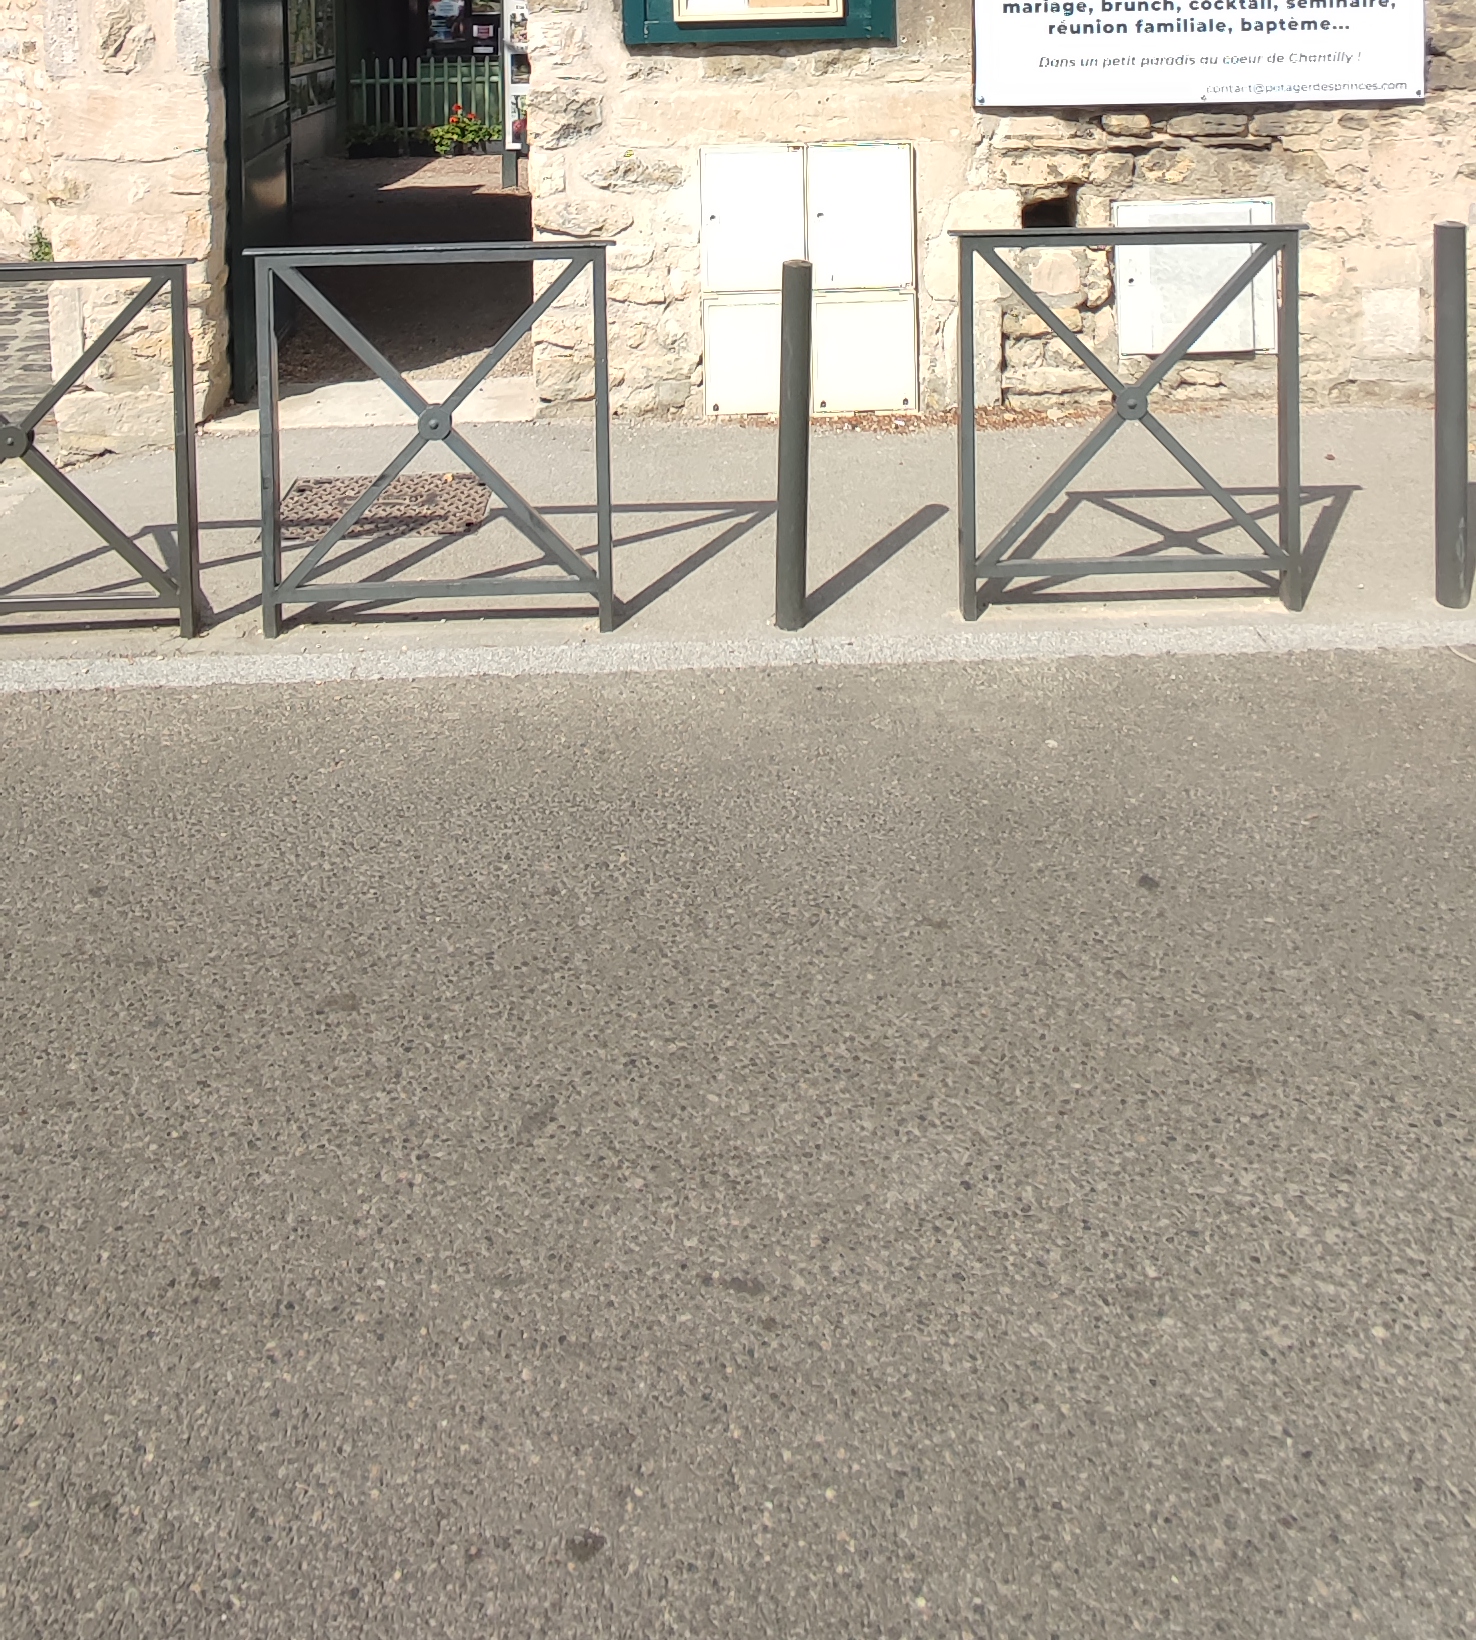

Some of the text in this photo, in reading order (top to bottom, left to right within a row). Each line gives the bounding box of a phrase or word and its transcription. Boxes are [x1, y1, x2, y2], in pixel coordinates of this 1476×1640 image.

[1048, 19, 1128, 34] réunion
[1135, 18, 1233, 34] familiale,
[1038, 56, 1076, 68] Dans
[1080, 57, 1098, 67] un
[1102, 55, 1136, 69] petit
[1140, 54, 1195, 68] paradis
[1199, 55, 1218, 65] au
[1222, 54, 1263, 65] coeur
[1267, 53, 1284, 63] de
[1289, 52, 1353, 64] Chantilly
[1206, 81, 1408, 95] contact@potagerdesprinces.com
